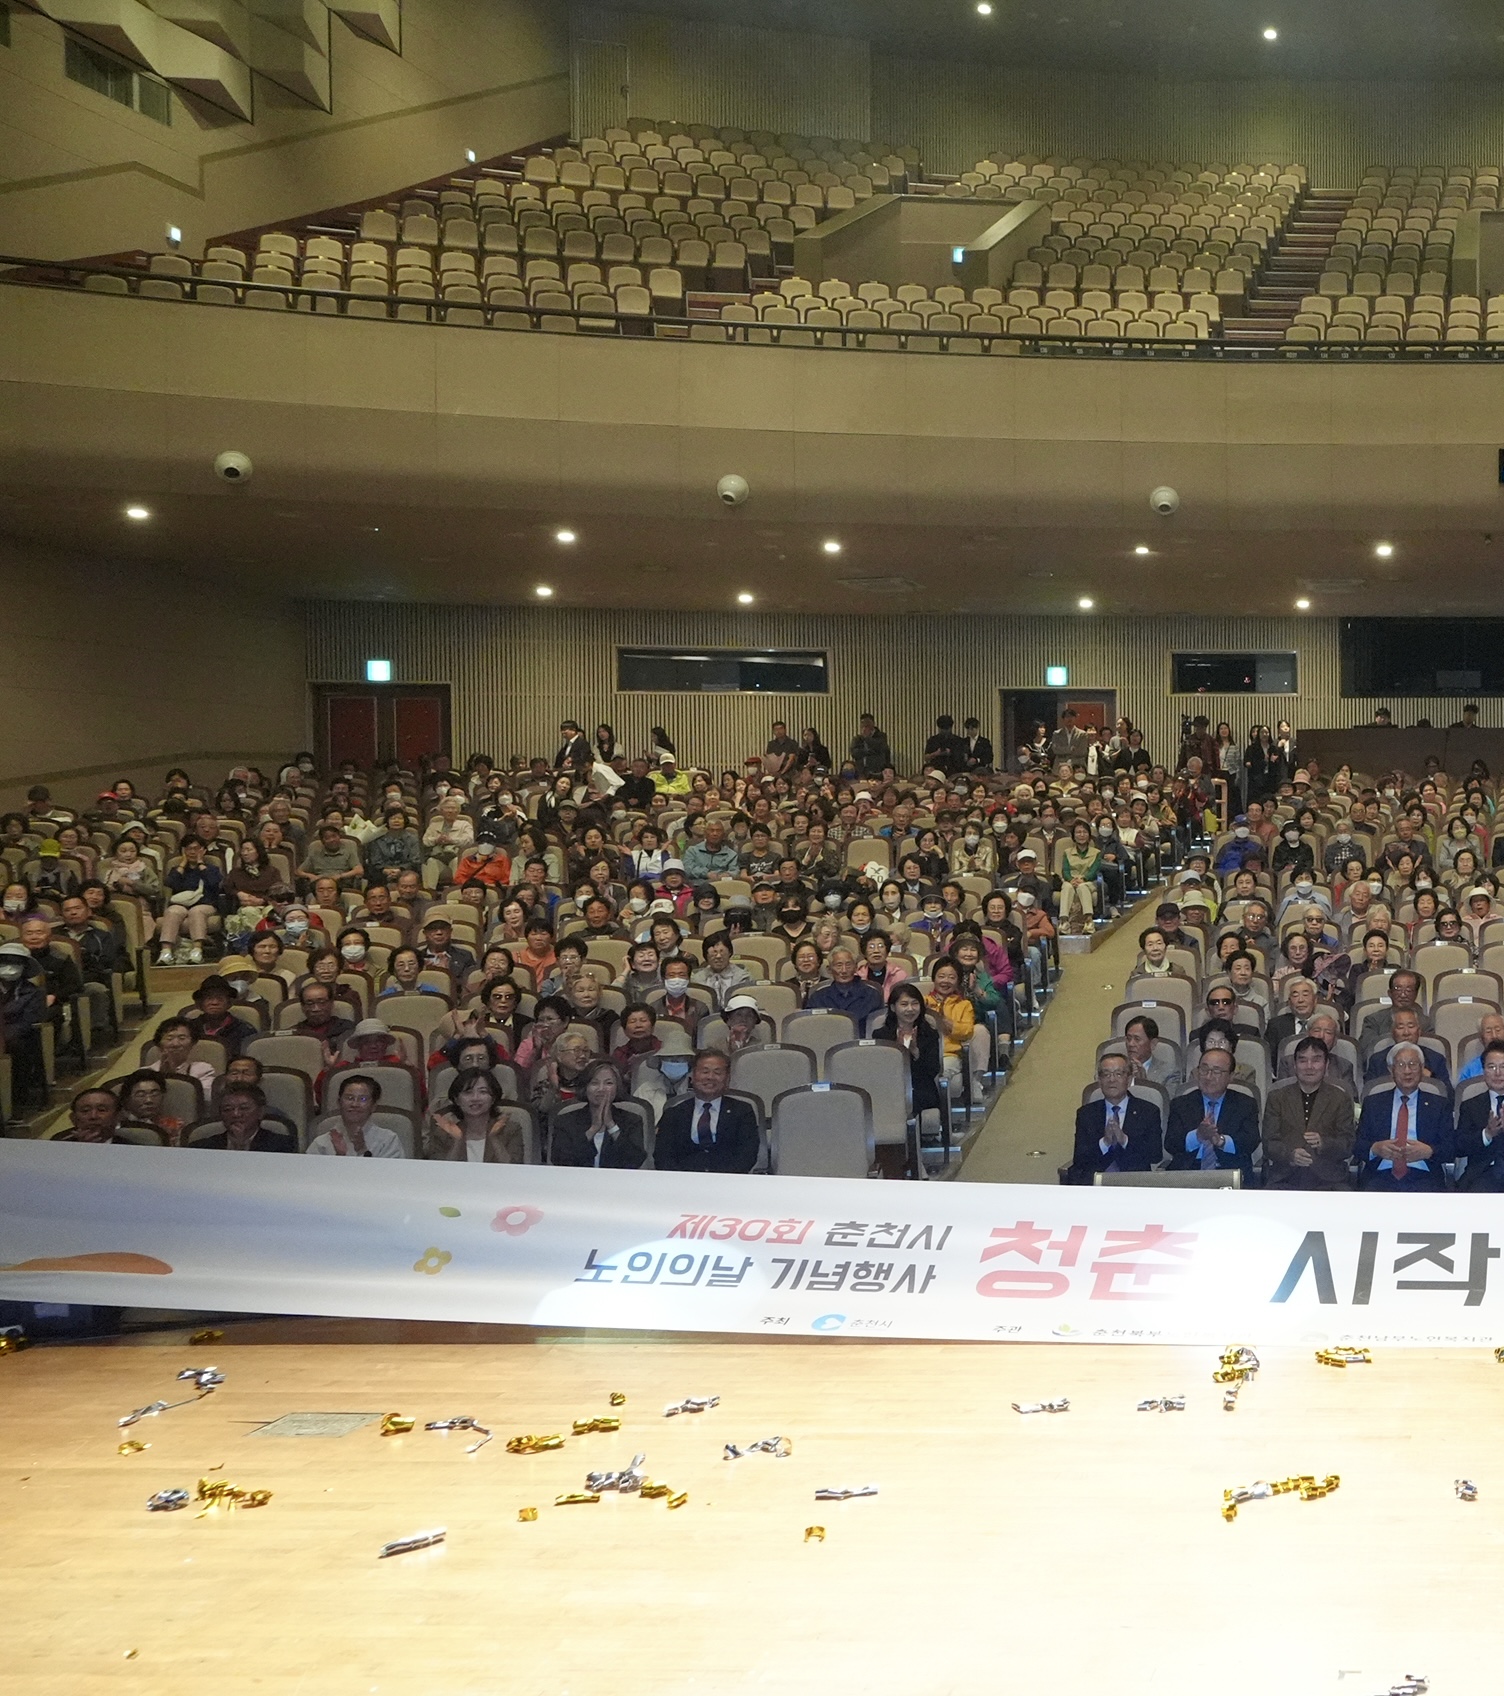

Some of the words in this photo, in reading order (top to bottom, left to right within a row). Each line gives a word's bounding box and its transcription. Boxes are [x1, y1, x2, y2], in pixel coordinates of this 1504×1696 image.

[666, 1213, 815, 1245] 제30회
[824, 1220, 953, 1251] 춘천시
[574, 1248, 754, 1288] 노인의날
[769, 1257, 937, 1294] 기념행사
[975, 1220, 1200, 1301] 청춘
[760, 1316, 791, 1326] 주최
[850, 1319, 893, 1329] 춘천시
[993, 1325, 1022, 1334] 주관
